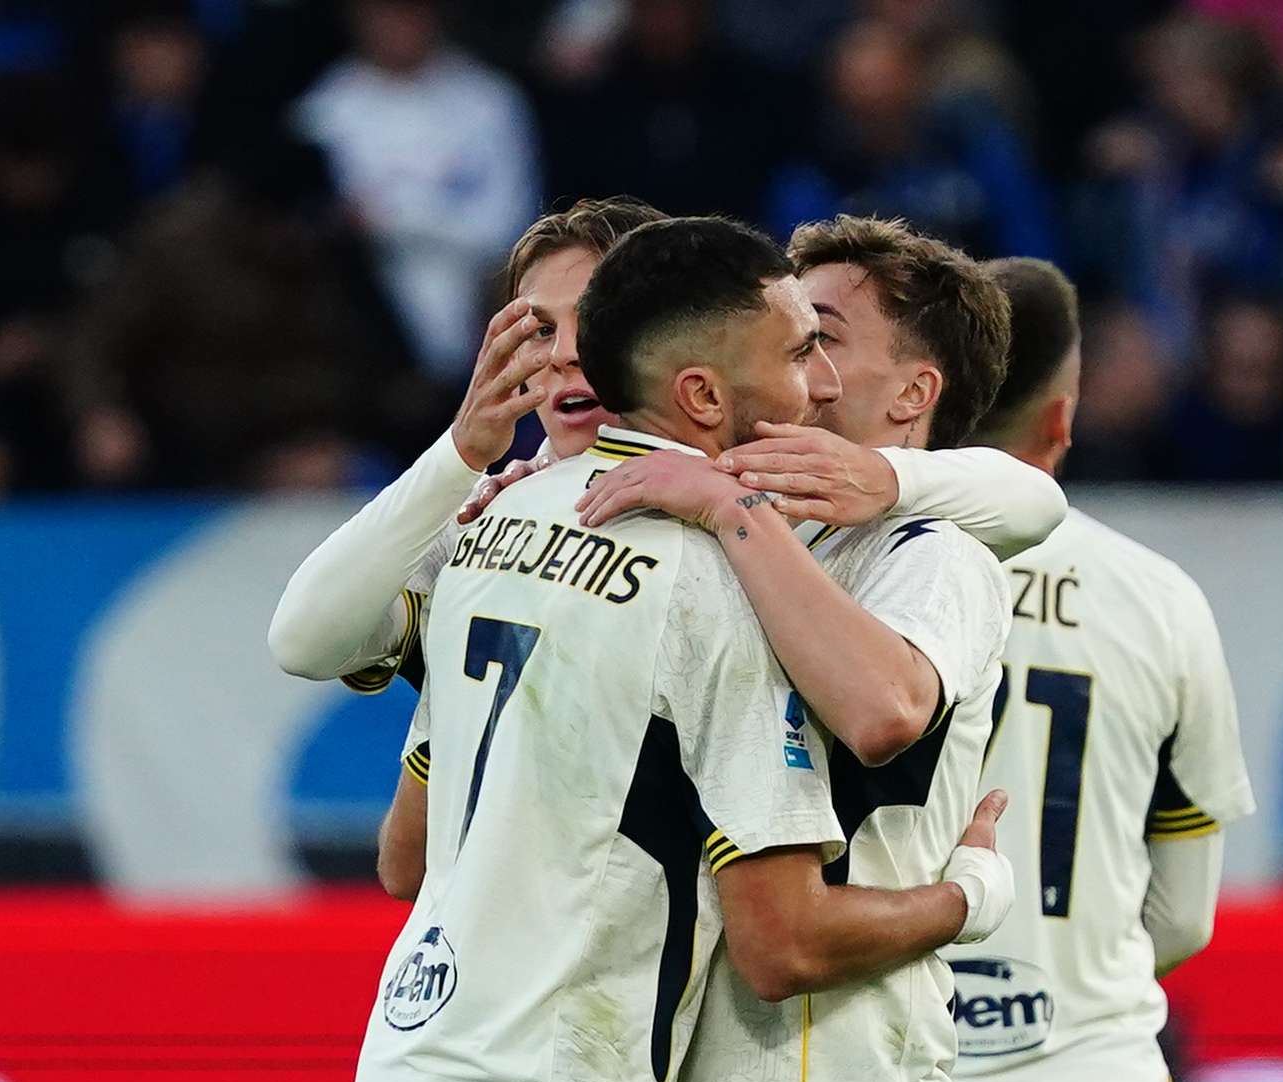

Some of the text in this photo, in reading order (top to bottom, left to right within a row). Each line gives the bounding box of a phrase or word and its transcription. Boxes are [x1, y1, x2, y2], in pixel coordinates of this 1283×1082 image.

[449, 515, 659, 604] GHEDJEMIS
[1011, 567, 1079, 627] ZIĆ
[456, 616, 542, 866] 7
[970, 664, 1093, 919] 1
